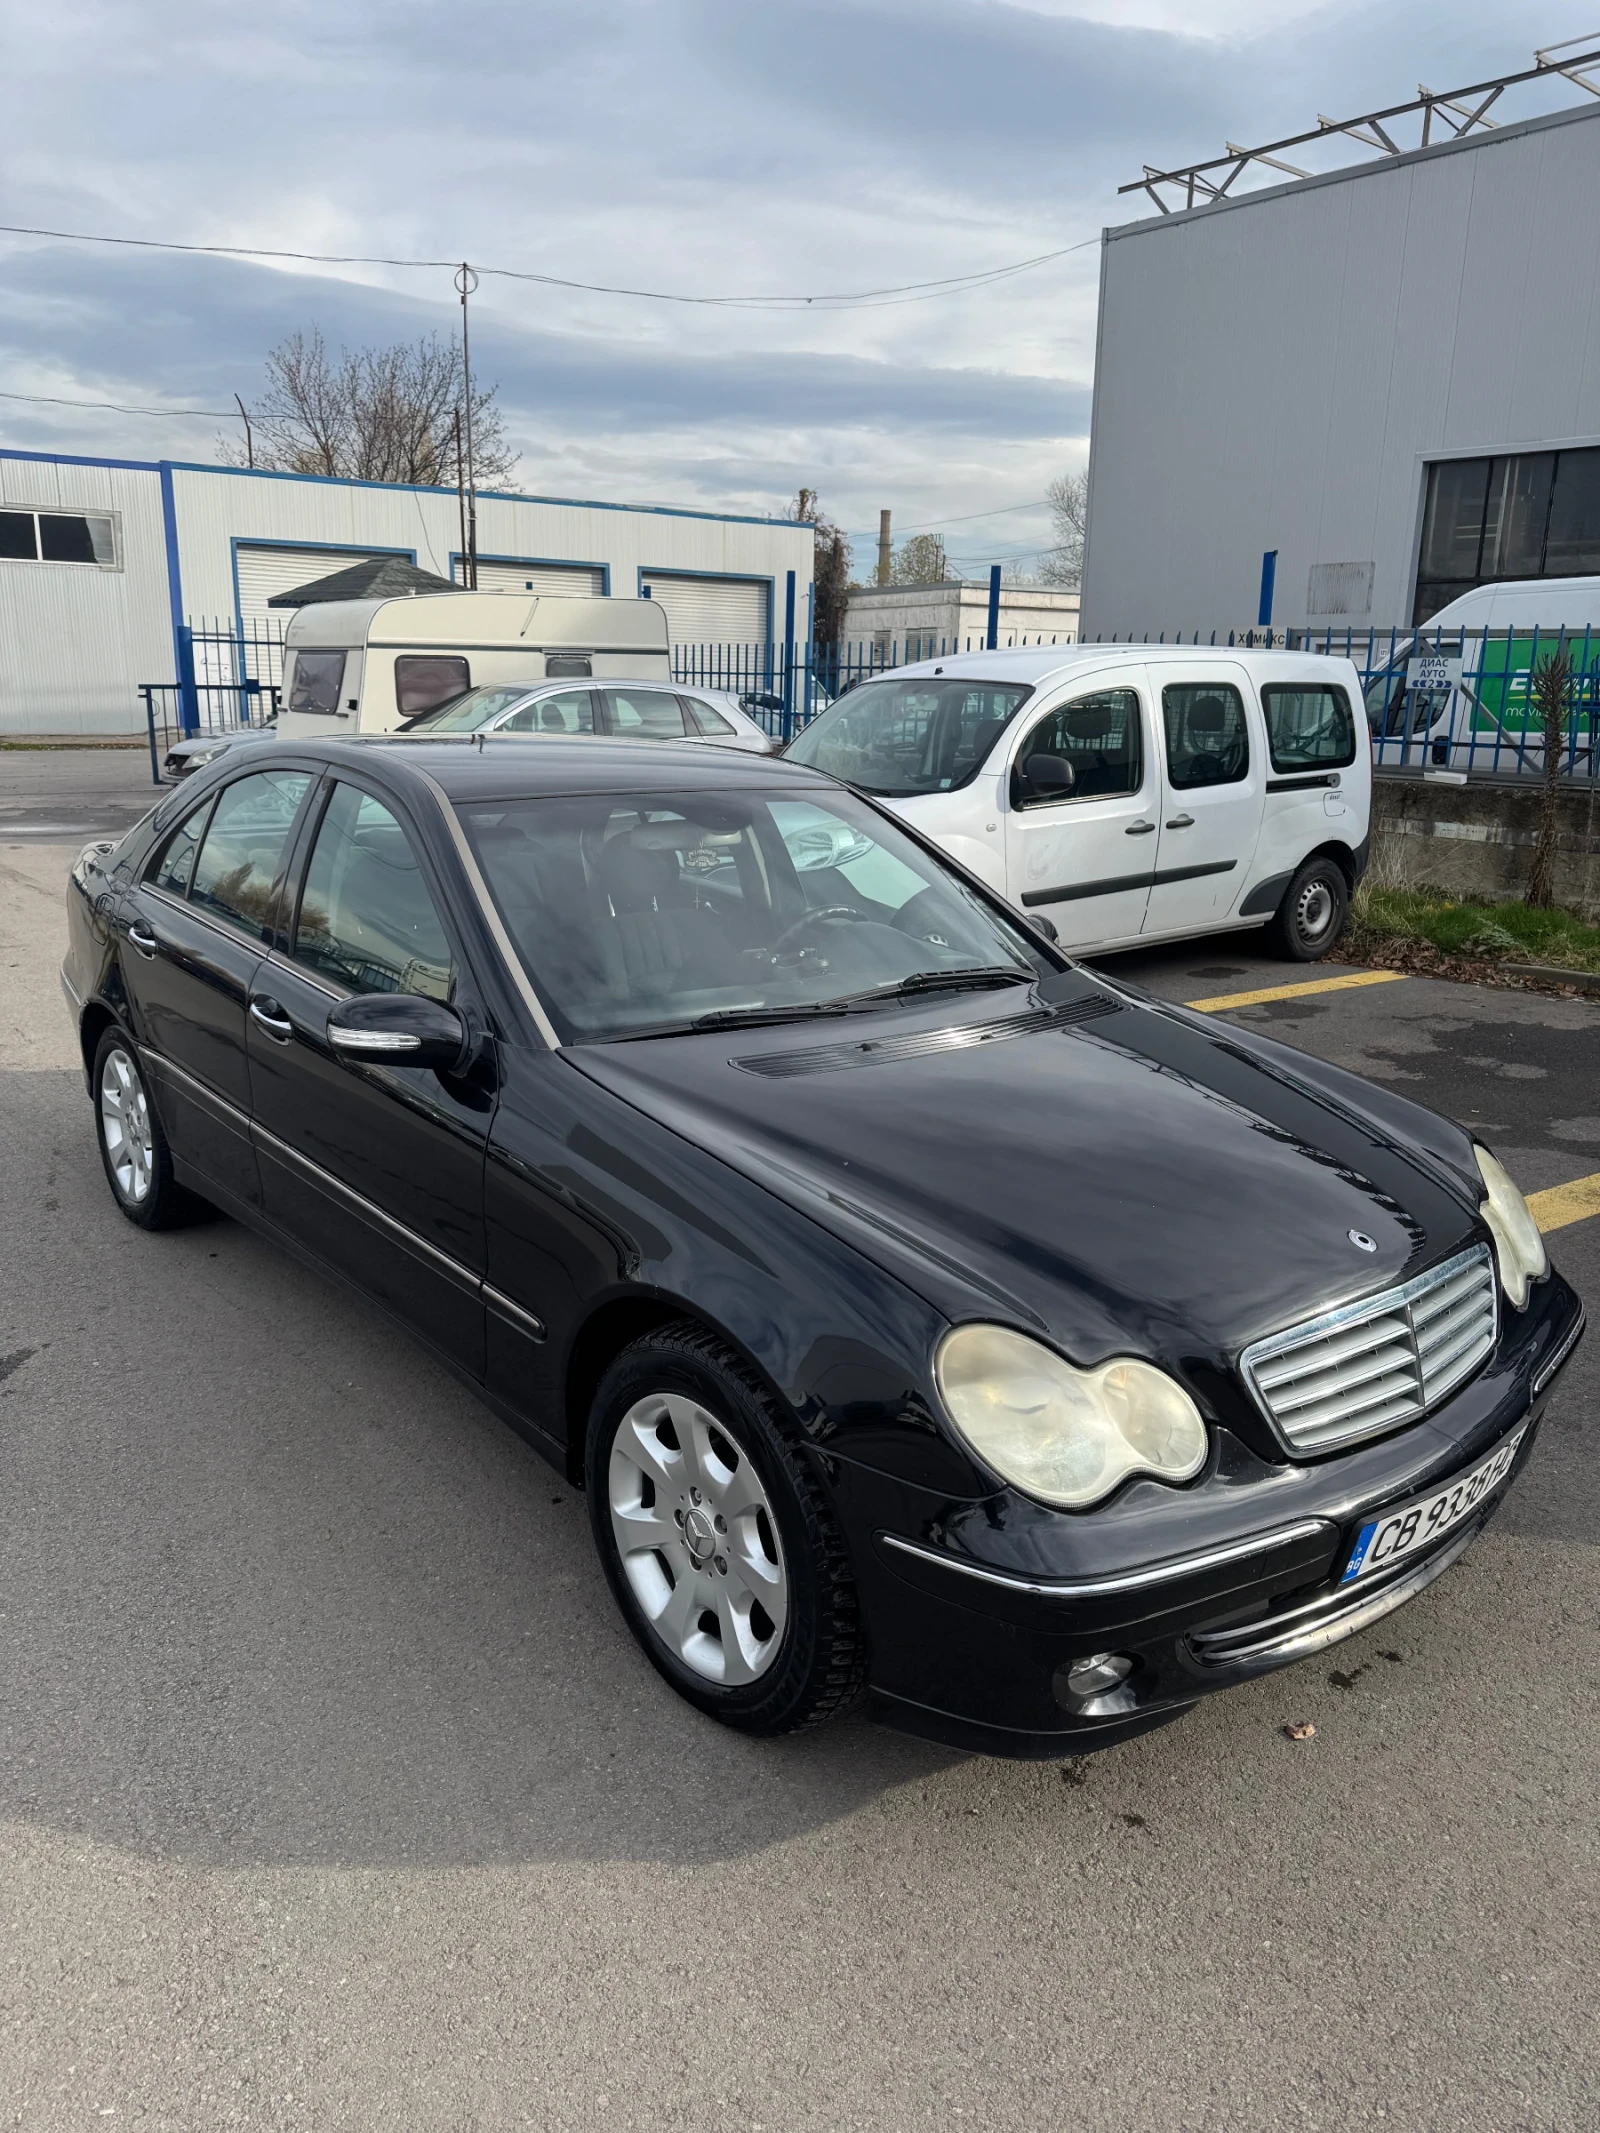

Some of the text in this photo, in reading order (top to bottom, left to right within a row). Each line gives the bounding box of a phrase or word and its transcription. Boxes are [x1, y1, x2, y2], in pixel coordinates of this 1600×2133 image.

[1238, 633, 1285, 645] ХМИКС
[1419, 658, 1449, 669] ДИАС
[1419, 669, 1446, 678] АУТО
[1428, 679, 1435, 689] 2
[1370, 1508, 1423, 1563] CB
[1421, 1463, 1493, 1540] 9338
[1347, 1556, 1362, 1574] BG
